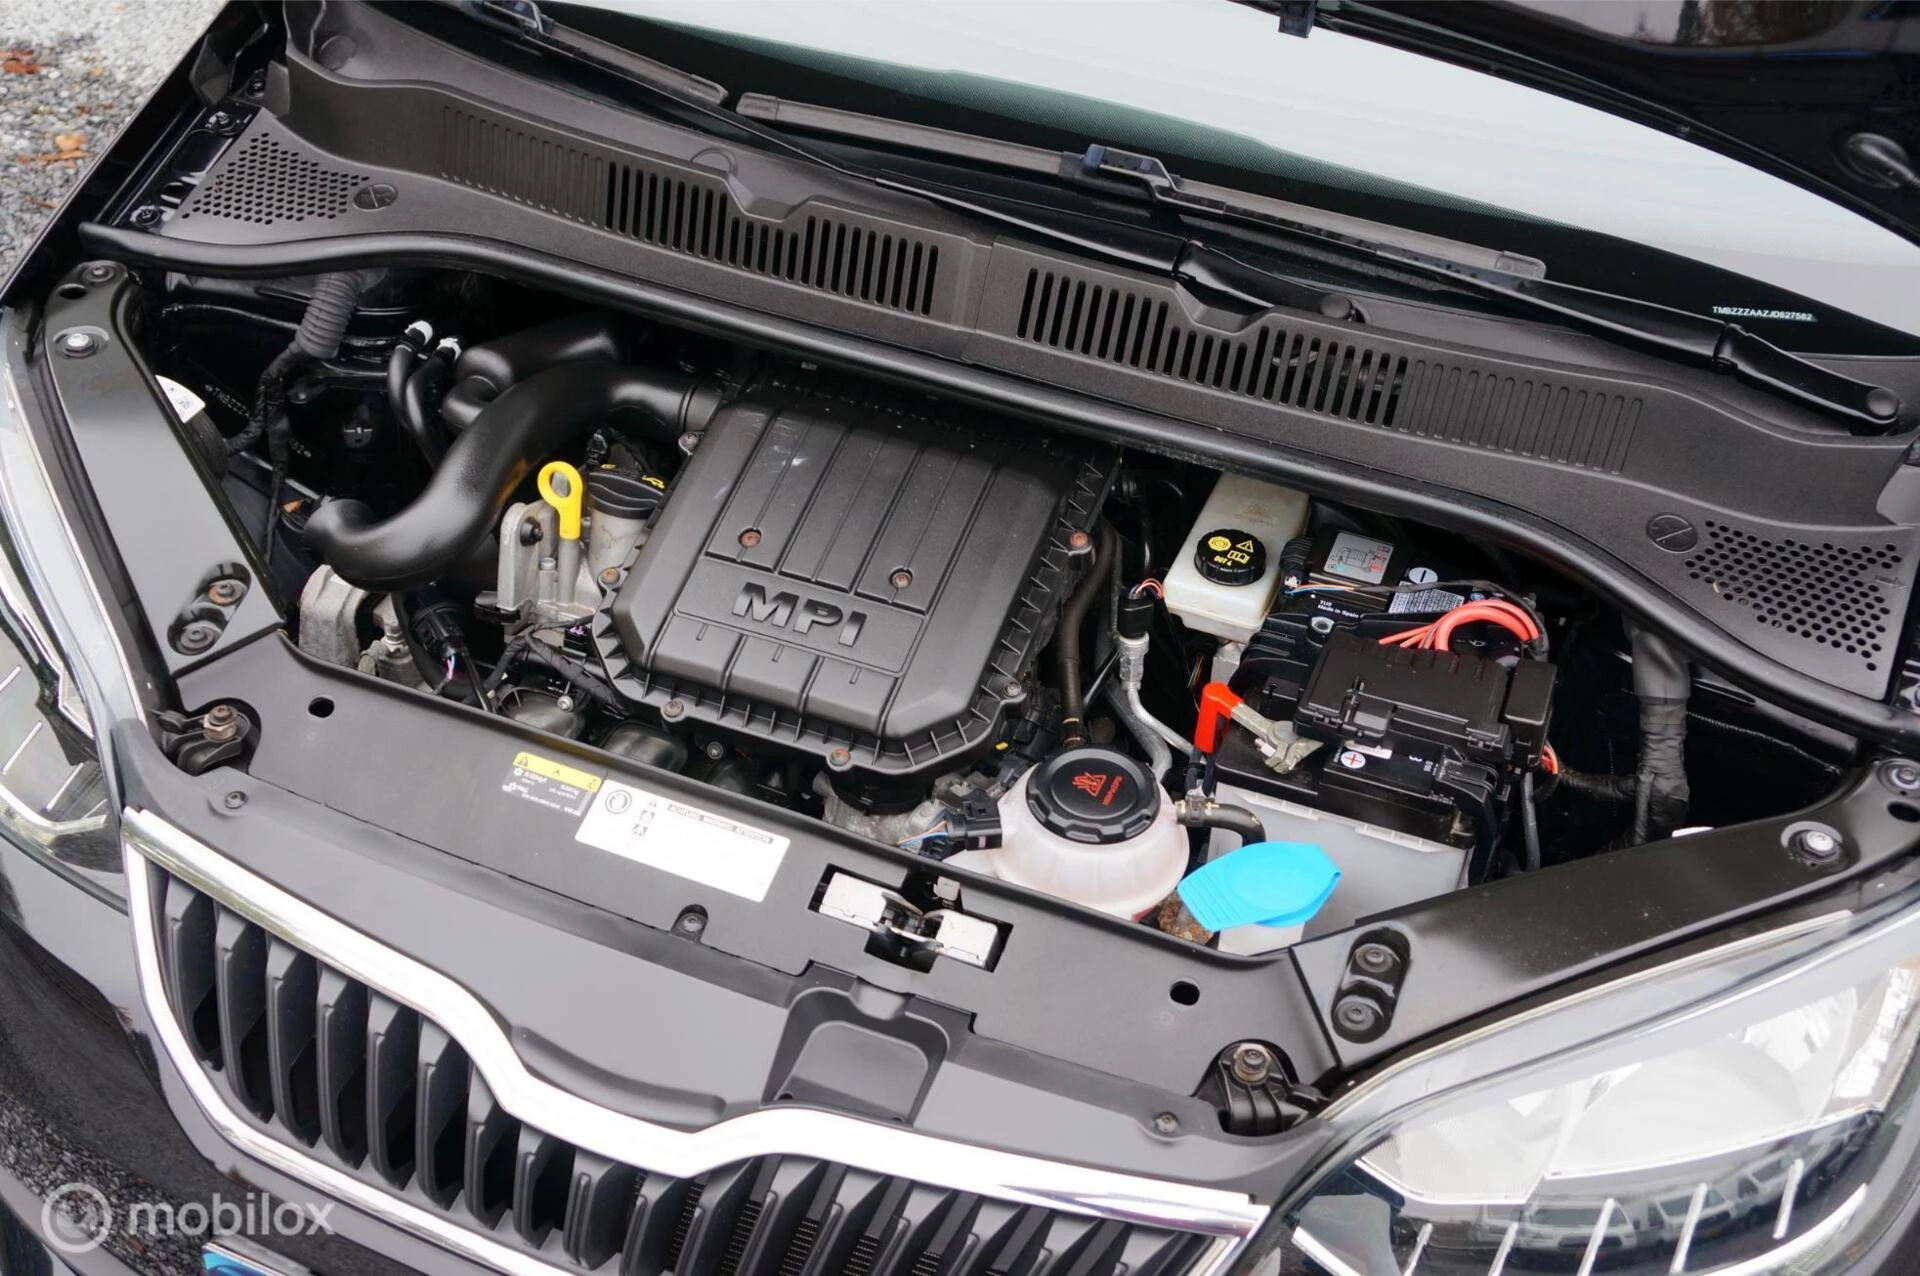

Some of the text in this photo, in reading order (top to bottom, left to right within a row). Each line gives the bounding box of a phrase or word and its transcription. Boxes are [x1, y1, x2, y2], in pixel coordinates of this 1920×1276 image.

[732, 582, 868, 646] MPI
[1318, 604, 1334, 613] Made
[1341, 609, 1359, 619] Spain
